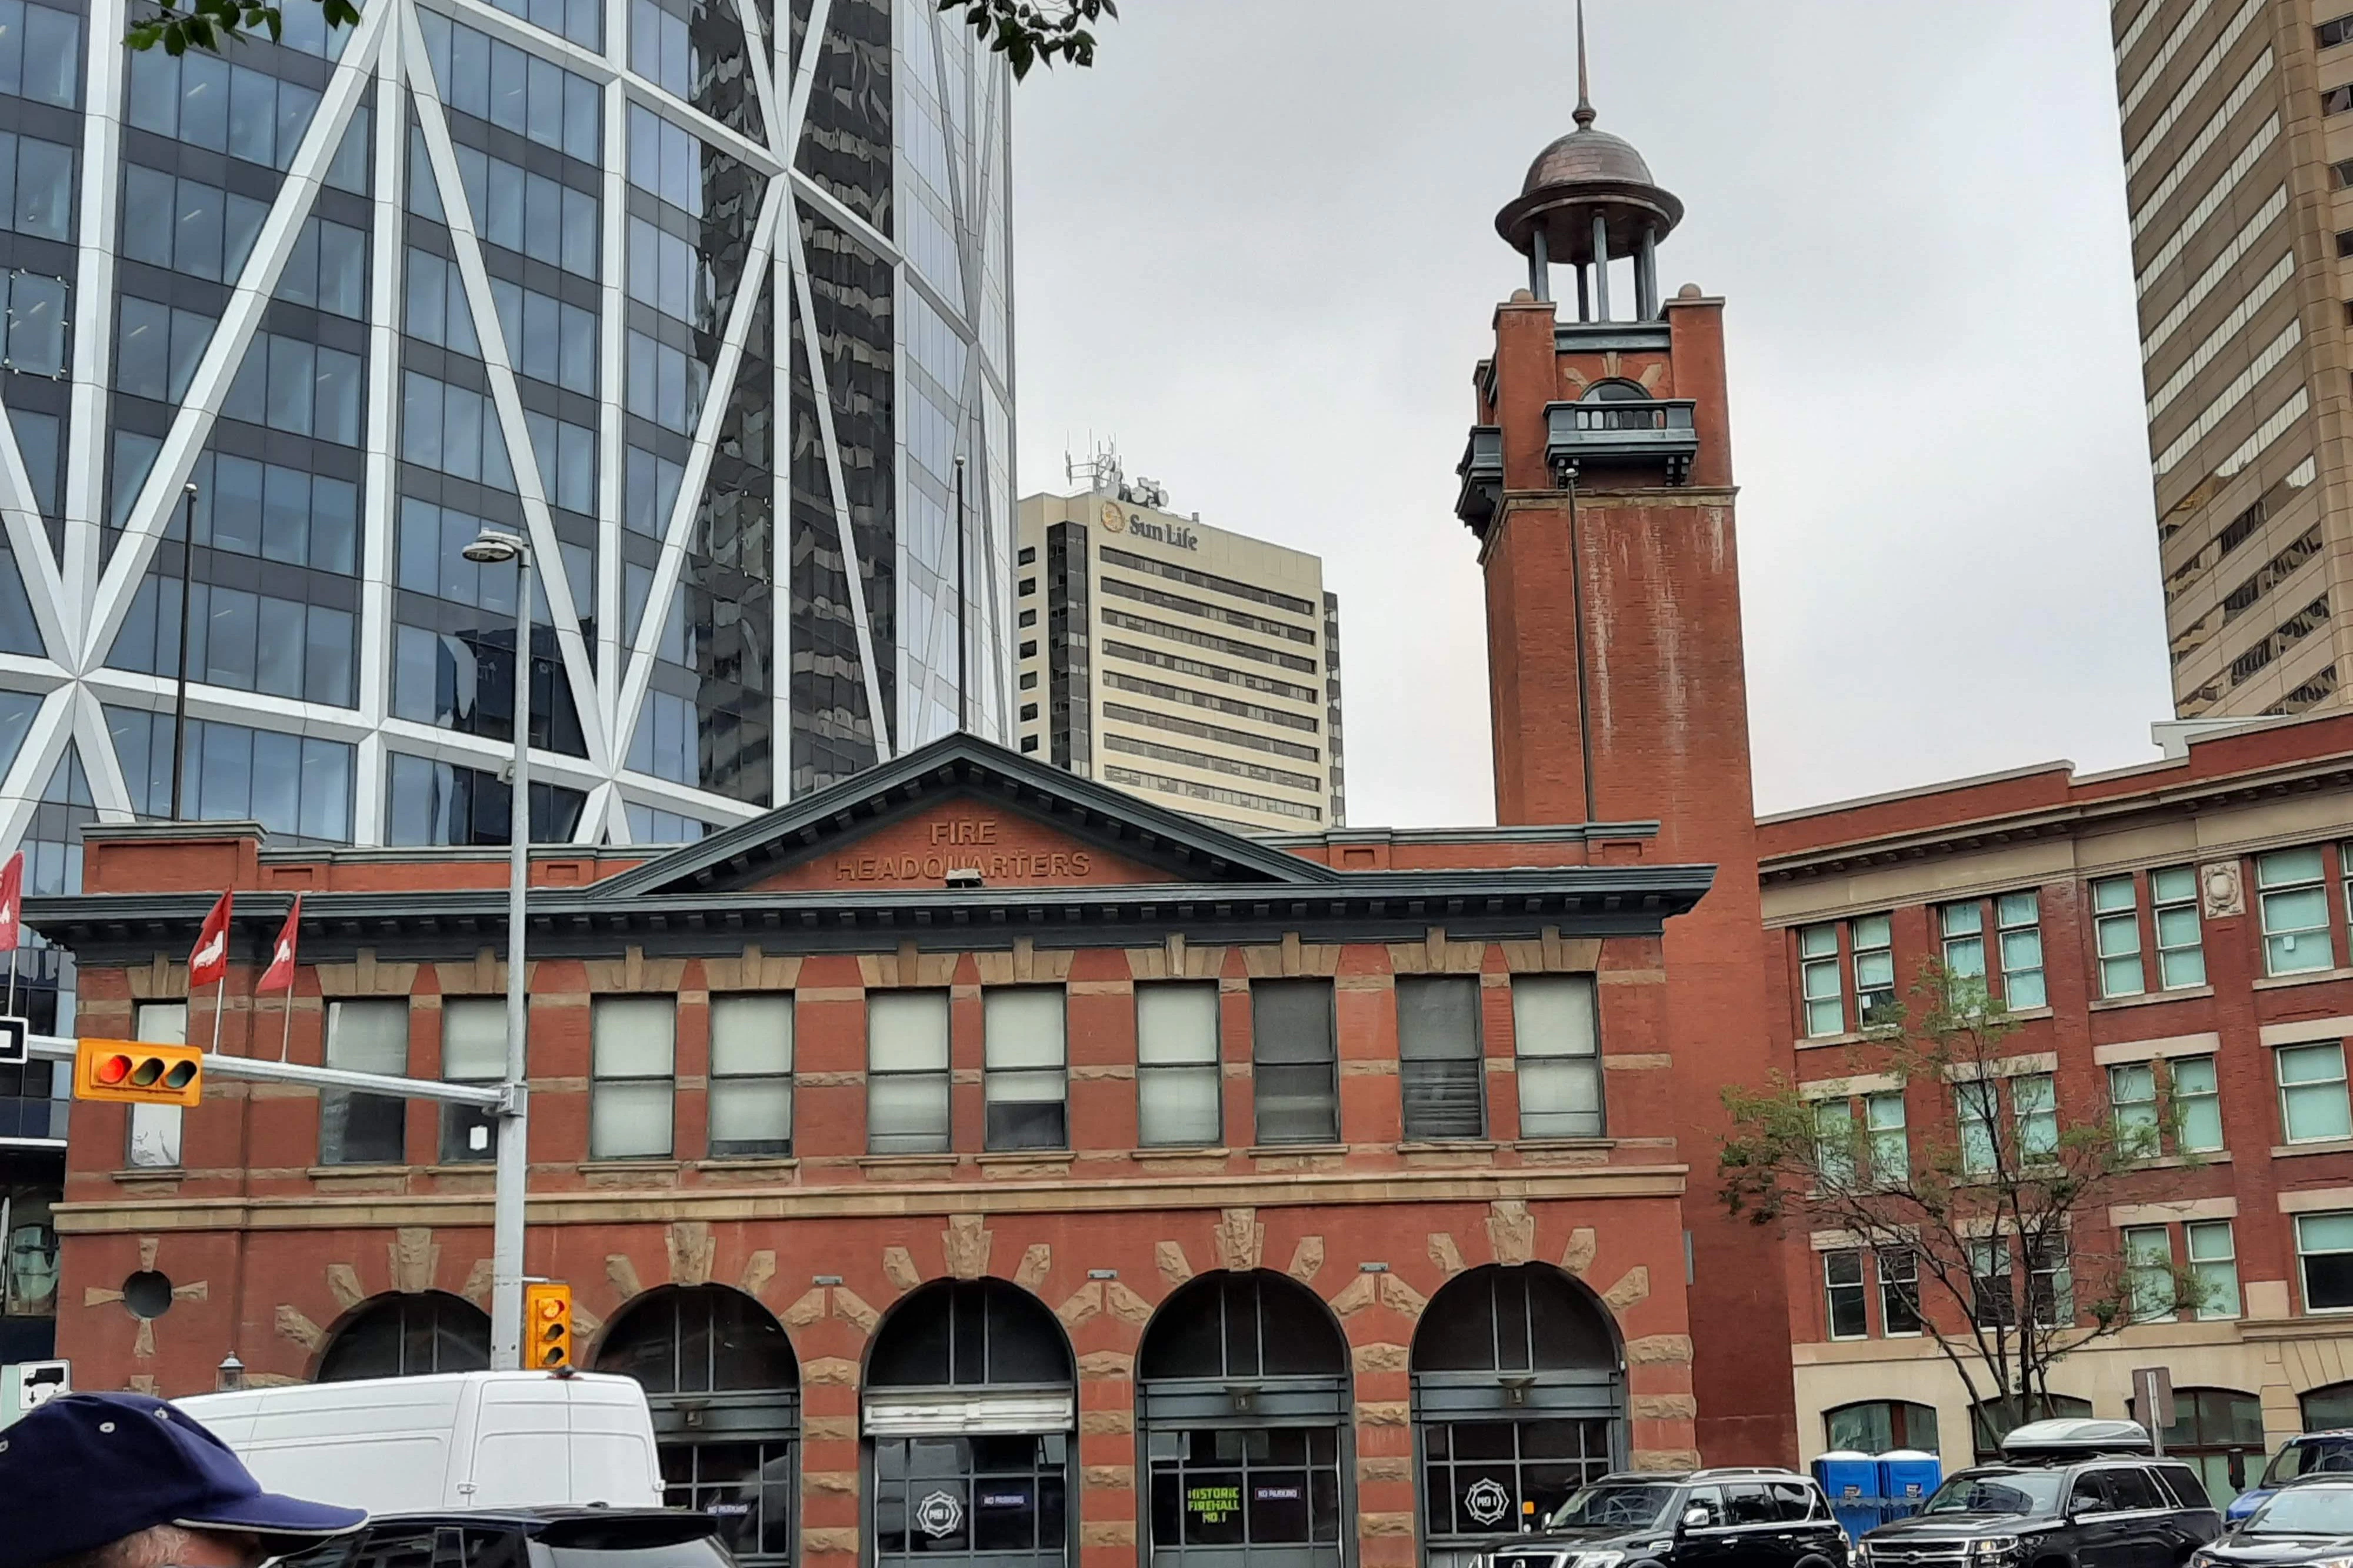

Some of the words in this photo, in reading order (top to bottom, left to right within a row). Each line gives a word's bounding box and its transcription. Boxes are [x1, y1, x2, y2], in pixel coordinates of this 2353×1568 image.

[1129, 514, 1163, 542] Sun
[1165, 523, 1198, 551] Life
[931, 820, 997, 846] FIRE
[836, 852, 1091, 880] HEADQUARTERS
[1188, 1487, 1239, 1499] HISTORIC
[1258, 1490, 1268, 1498] NO
[1269, 1489, 1298, 1498] PARKING
[1188, 1500, 1240, 1512] FIREHALL
